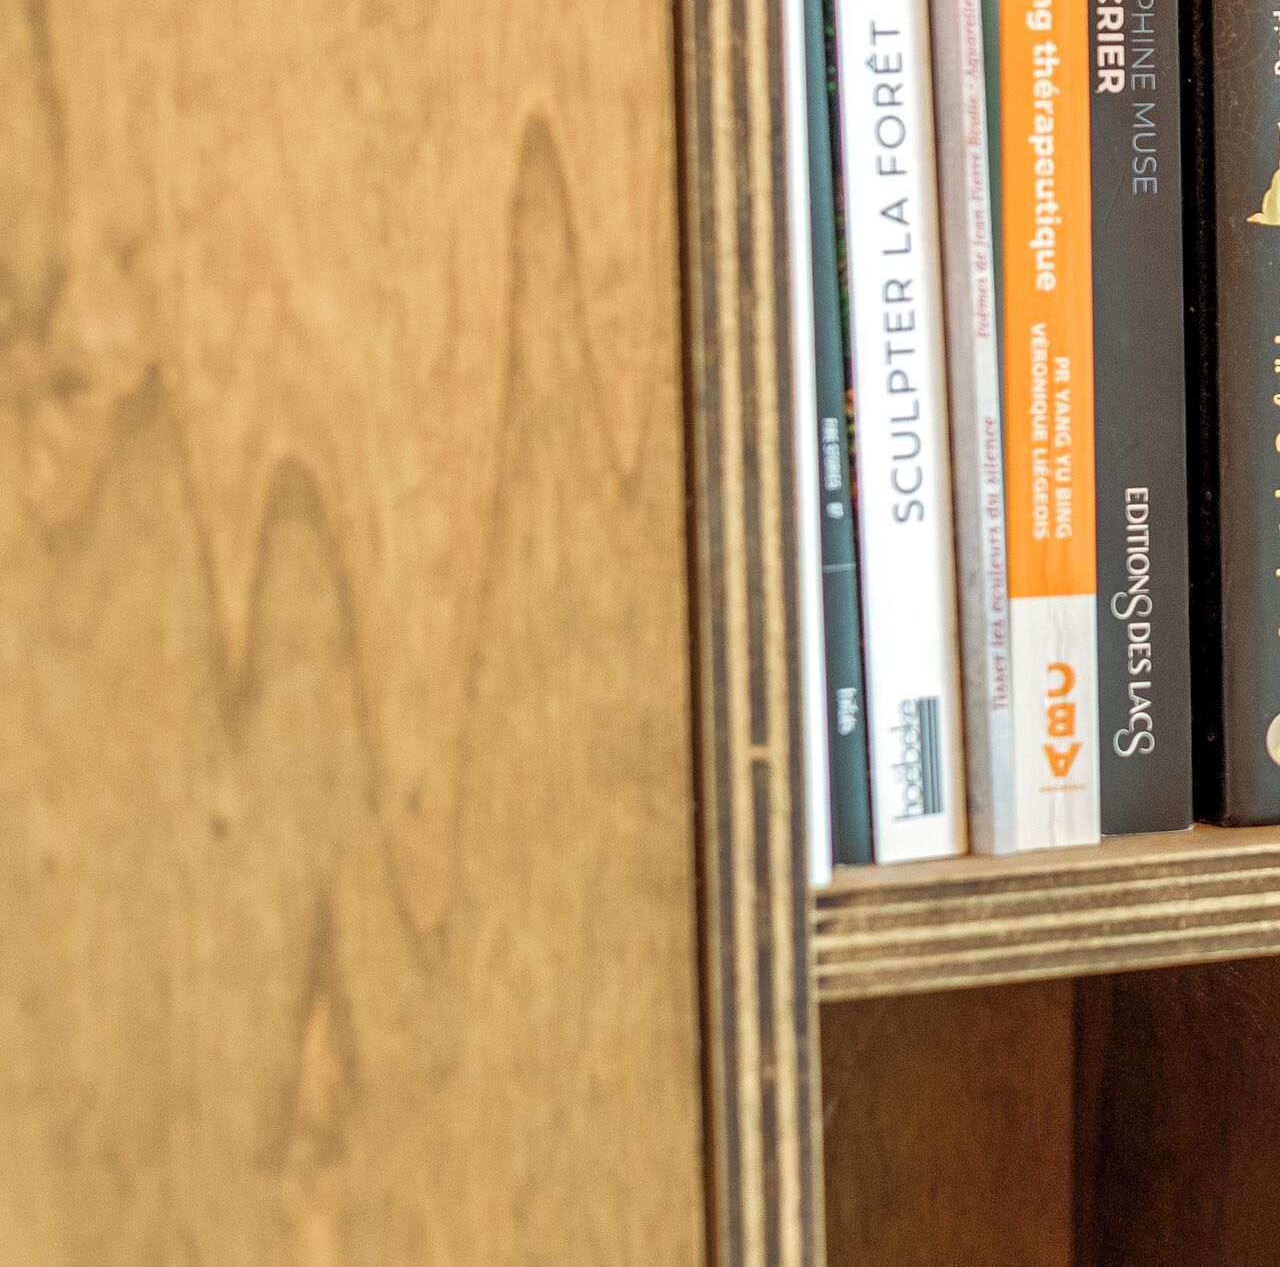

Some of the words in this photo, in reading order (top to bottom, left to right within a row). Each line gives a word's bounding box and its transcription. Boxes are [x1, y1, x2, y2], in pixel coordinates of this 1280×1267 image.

[864, 20, 907, 176] FORÊT
[1028, 40, 1062, 292] thérapeutique
[1131, 102, 1158, 195] MUSE
[881, 197, 912, 255] LA
[881, 277, 925, 523] SCULPTER
[1030, 322, 1050, 442] VÉRONIQUE
[1054, 356, 1070, 383] PR
[986, 415, 999, 485] silence
[1054, 388, 1071, 447] YANG
[1031, 447, 1052, 540] LIÉGEOIS
[1055, 453, 1071, 482] YU
[987, 493, 1000, 519] du
[1055, 487, 1072, 540] BING
[1110, 486, 1153, 620] EDITIONS
[1127, 621, 1151, 676] DES
[1113, 681, 1155, 758] LACS
